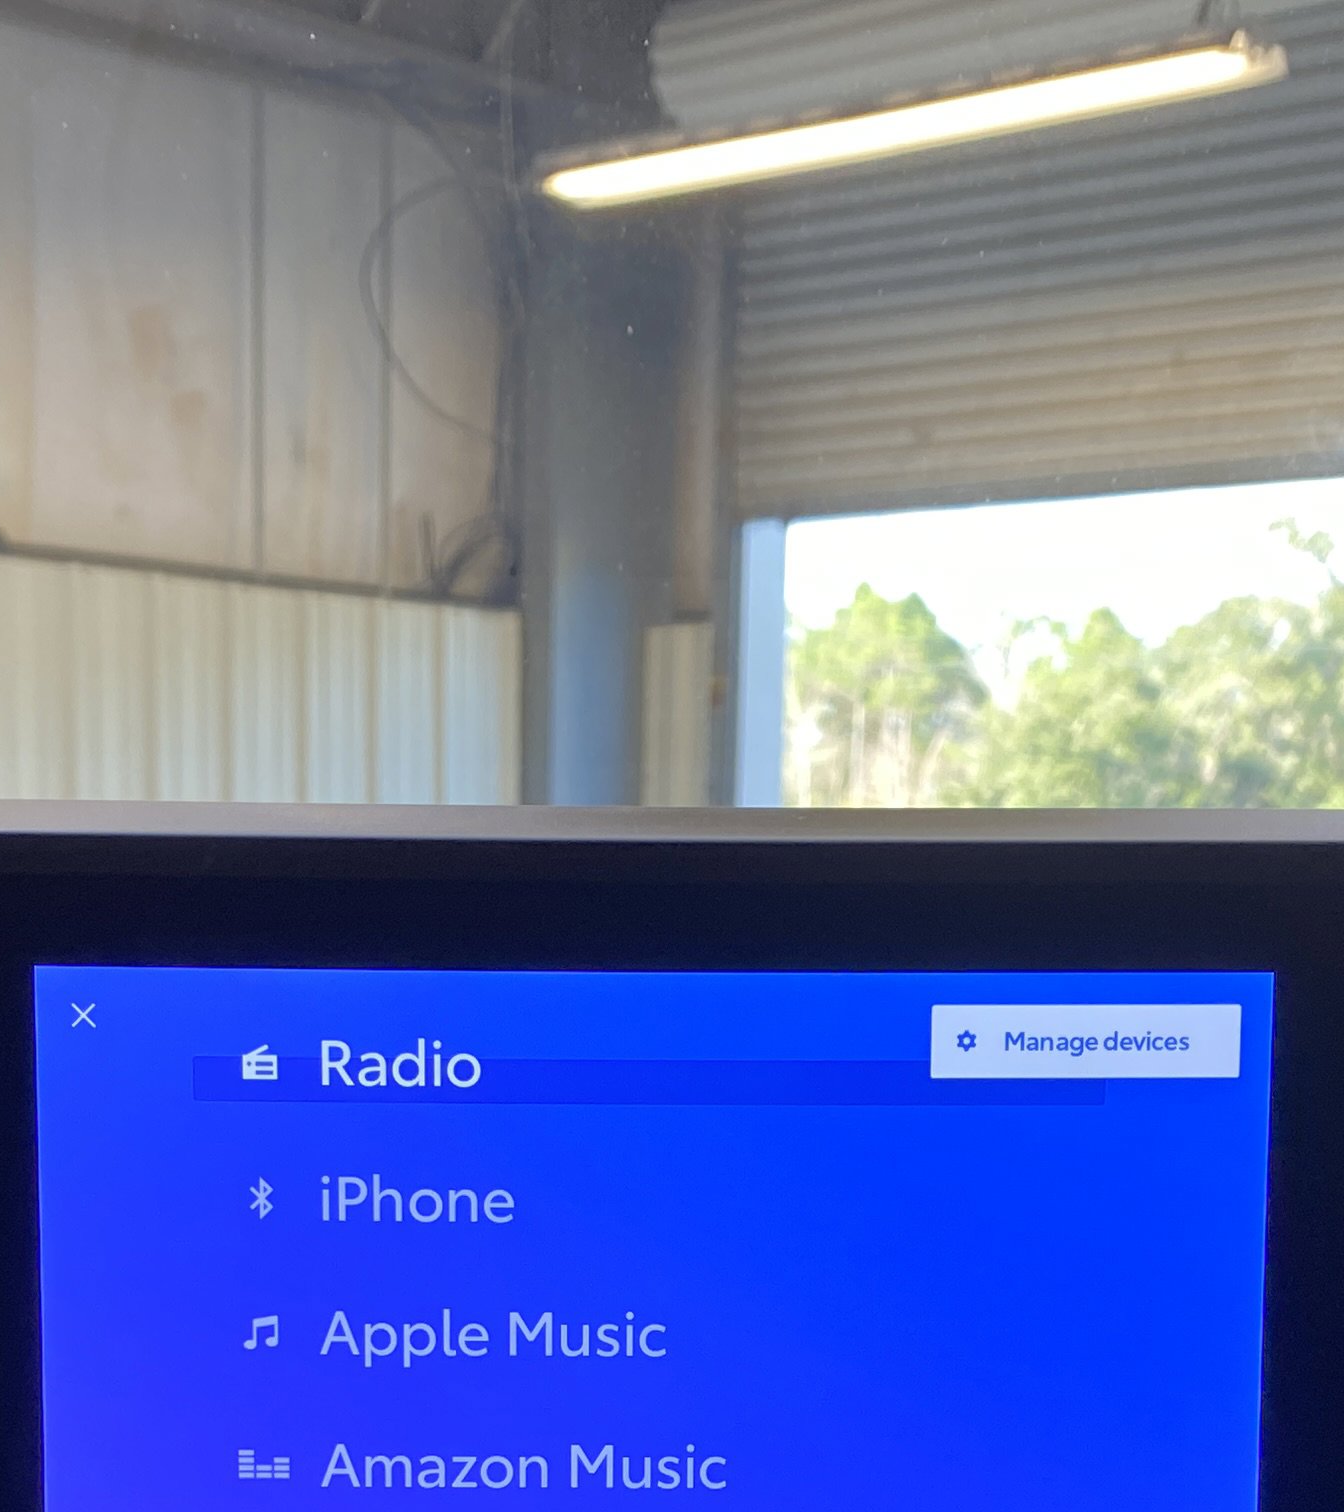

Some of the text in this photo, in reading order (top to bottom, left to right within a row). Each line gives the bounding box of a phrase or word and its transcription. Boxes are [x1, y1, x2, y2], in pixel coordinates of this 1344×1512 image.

[320, 1037, 482, 1088] Radio
[1004, 1031, 1190, 1057] Manage devices
[321, 1173, 515, 1224] iPhone
[319, 1308, 667, 1368] Apple Music
[320, 1443, 727, 1490] Amazon Music
